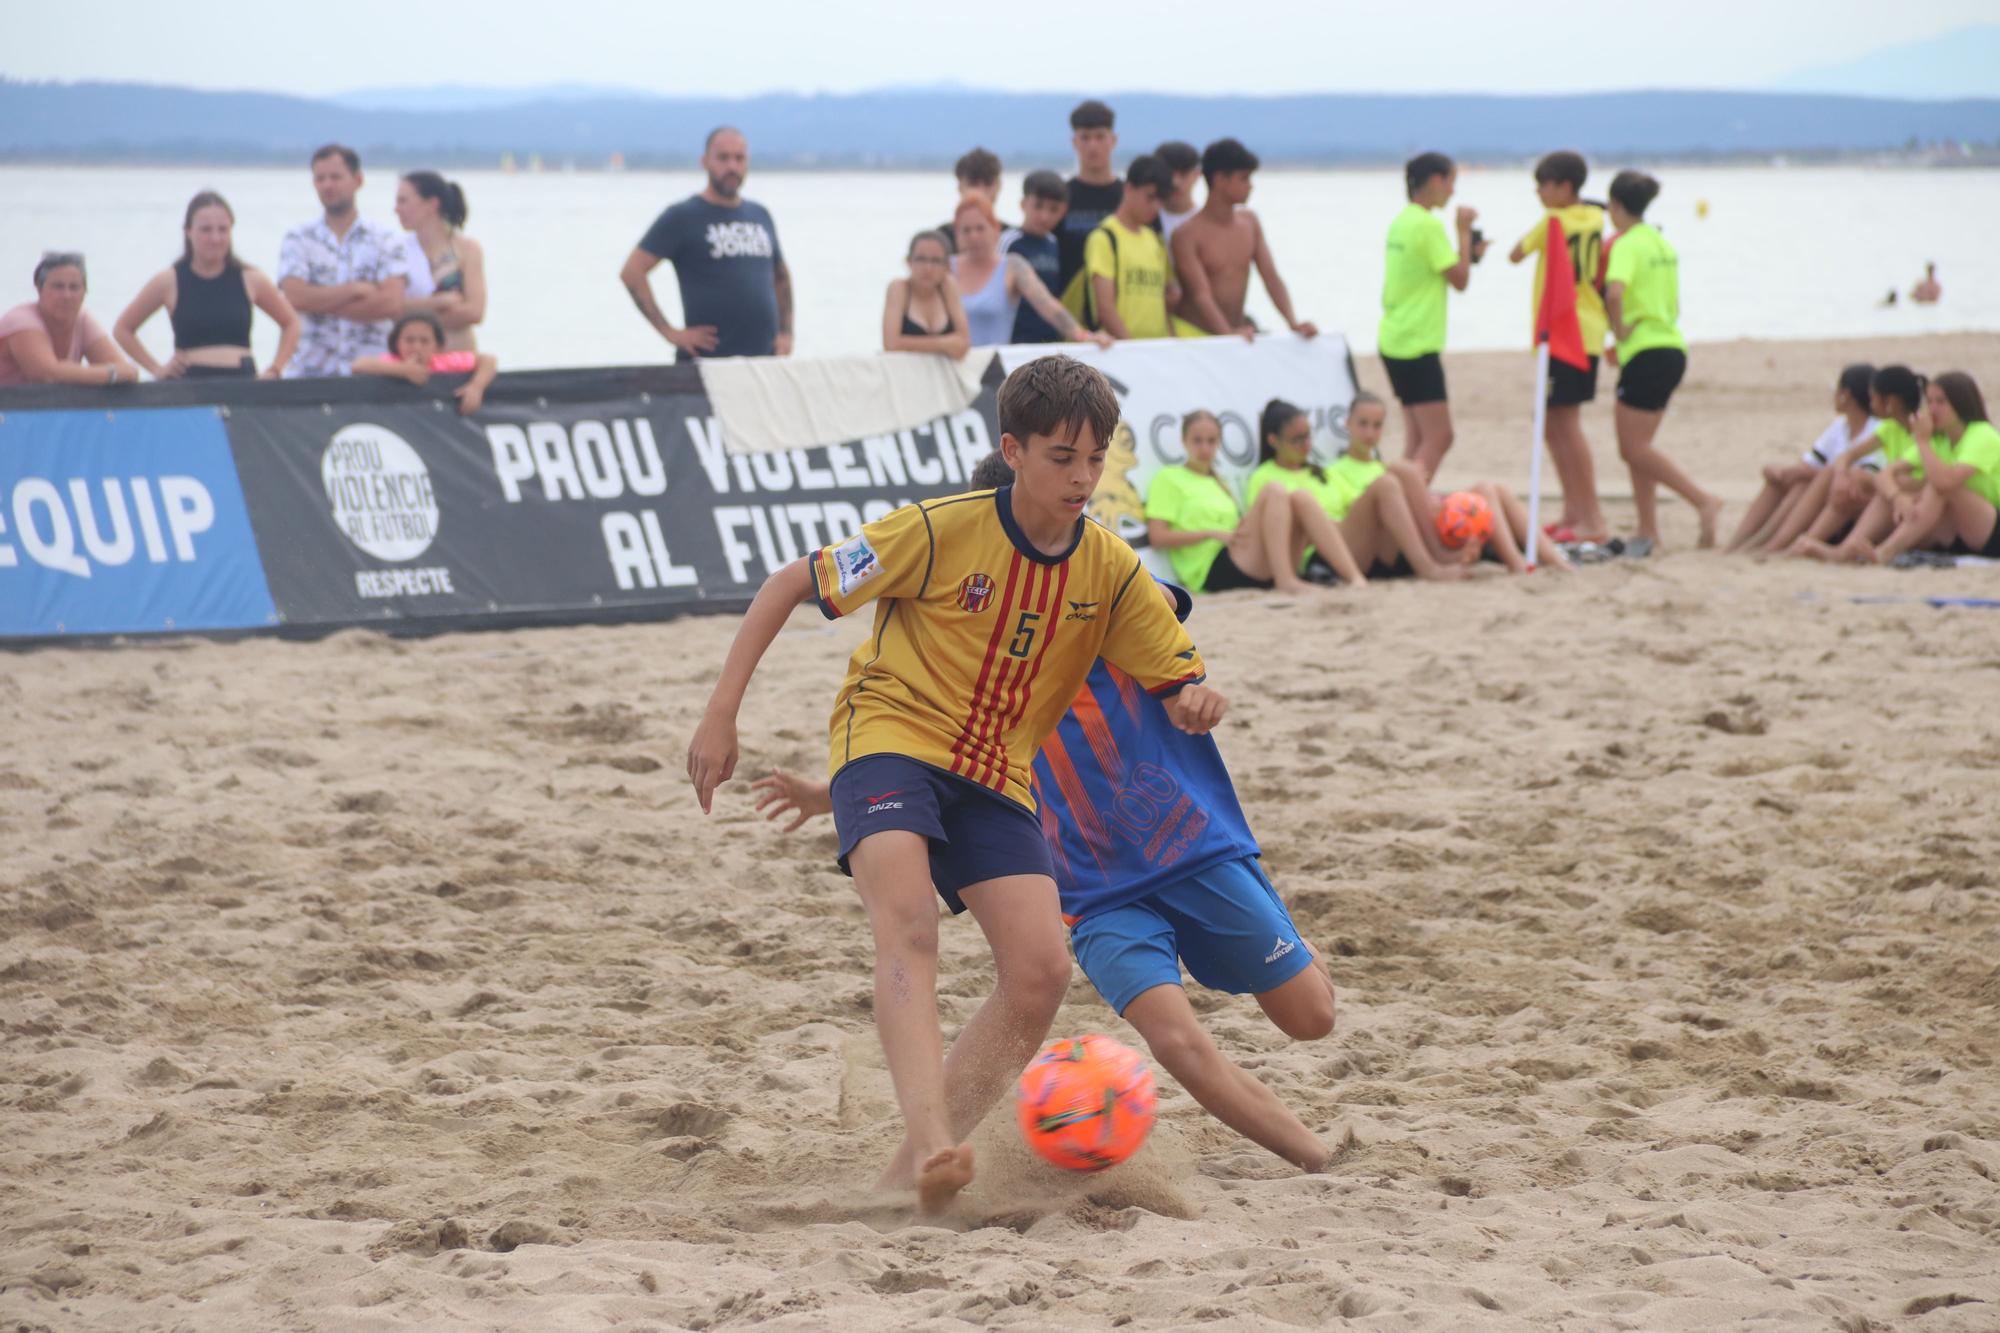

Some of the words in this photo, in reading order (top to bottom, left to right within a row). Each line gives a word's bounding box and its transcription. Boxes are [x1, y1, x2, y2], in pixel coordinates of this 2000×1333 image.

[331, 440, 383, 471] PROU
[485, 417, 667, 503] PROU
[685, 407, 993, 493] VIOLENCIA
[601, 509, 699, 589] AL
[713, 499, 912, 584] FUT
[355, 567, 454, 598] RESPECTE
[1009, 612, 1041, 658] 5
[867, 801, 904, 814] ONZE
